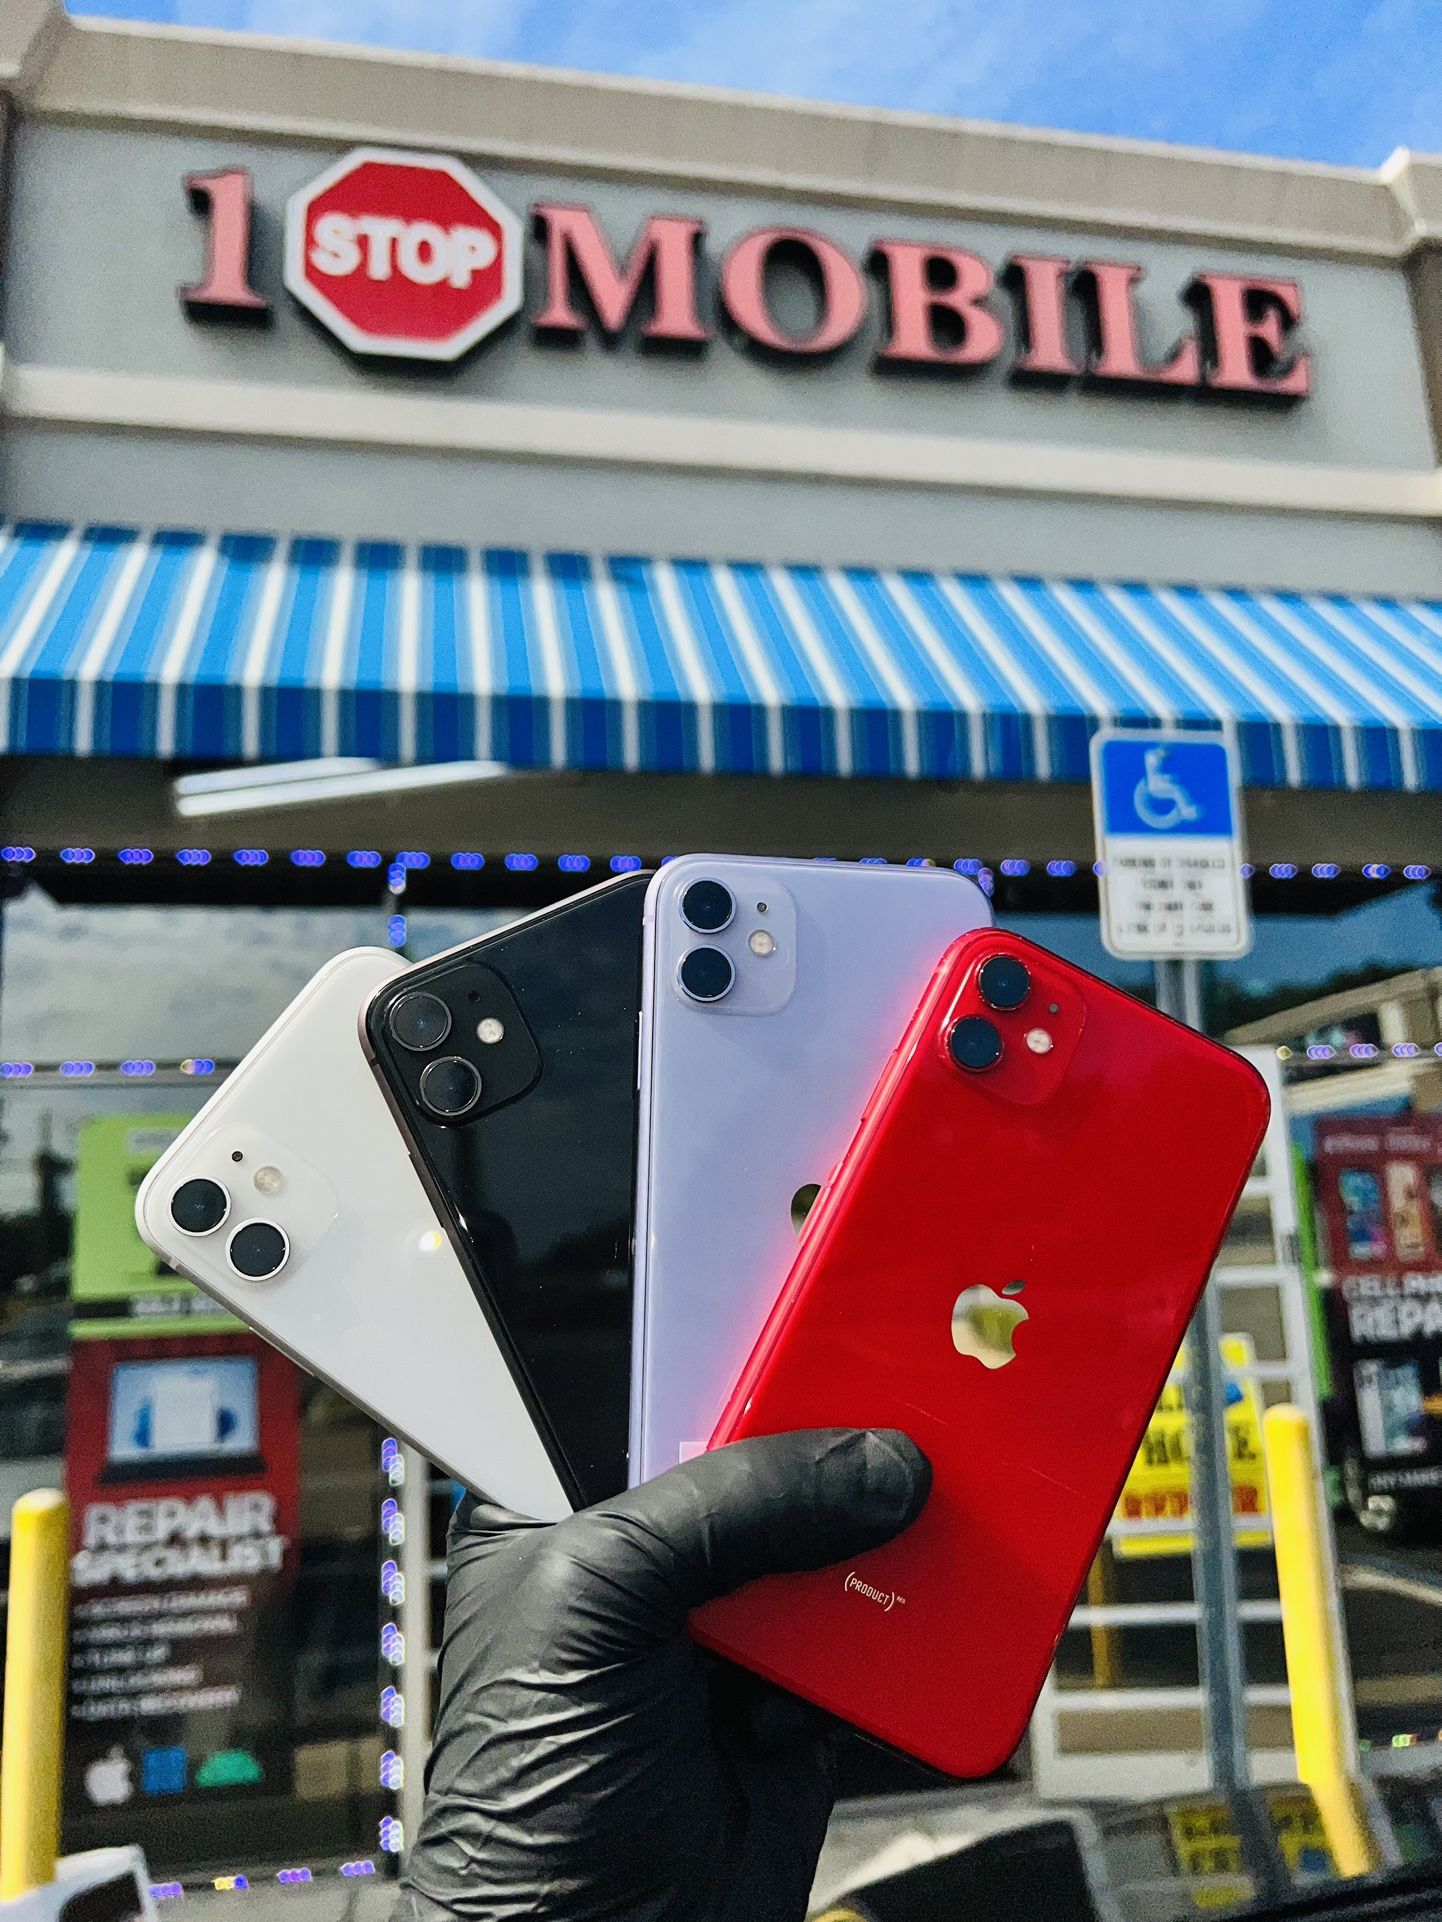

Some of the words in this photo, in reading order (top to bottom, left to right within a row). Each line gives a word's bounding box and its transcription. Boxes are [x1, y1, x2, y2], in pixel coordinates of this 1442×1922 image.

[181, 167, 268, 310] 1
[309, 211, 498, 290] STOP
[531, 202, 1314, 396] MOBILE
[83, 1490, 277, 1548] REPAIR
[844, 1571, 895, 1612] (PRODUCT)
